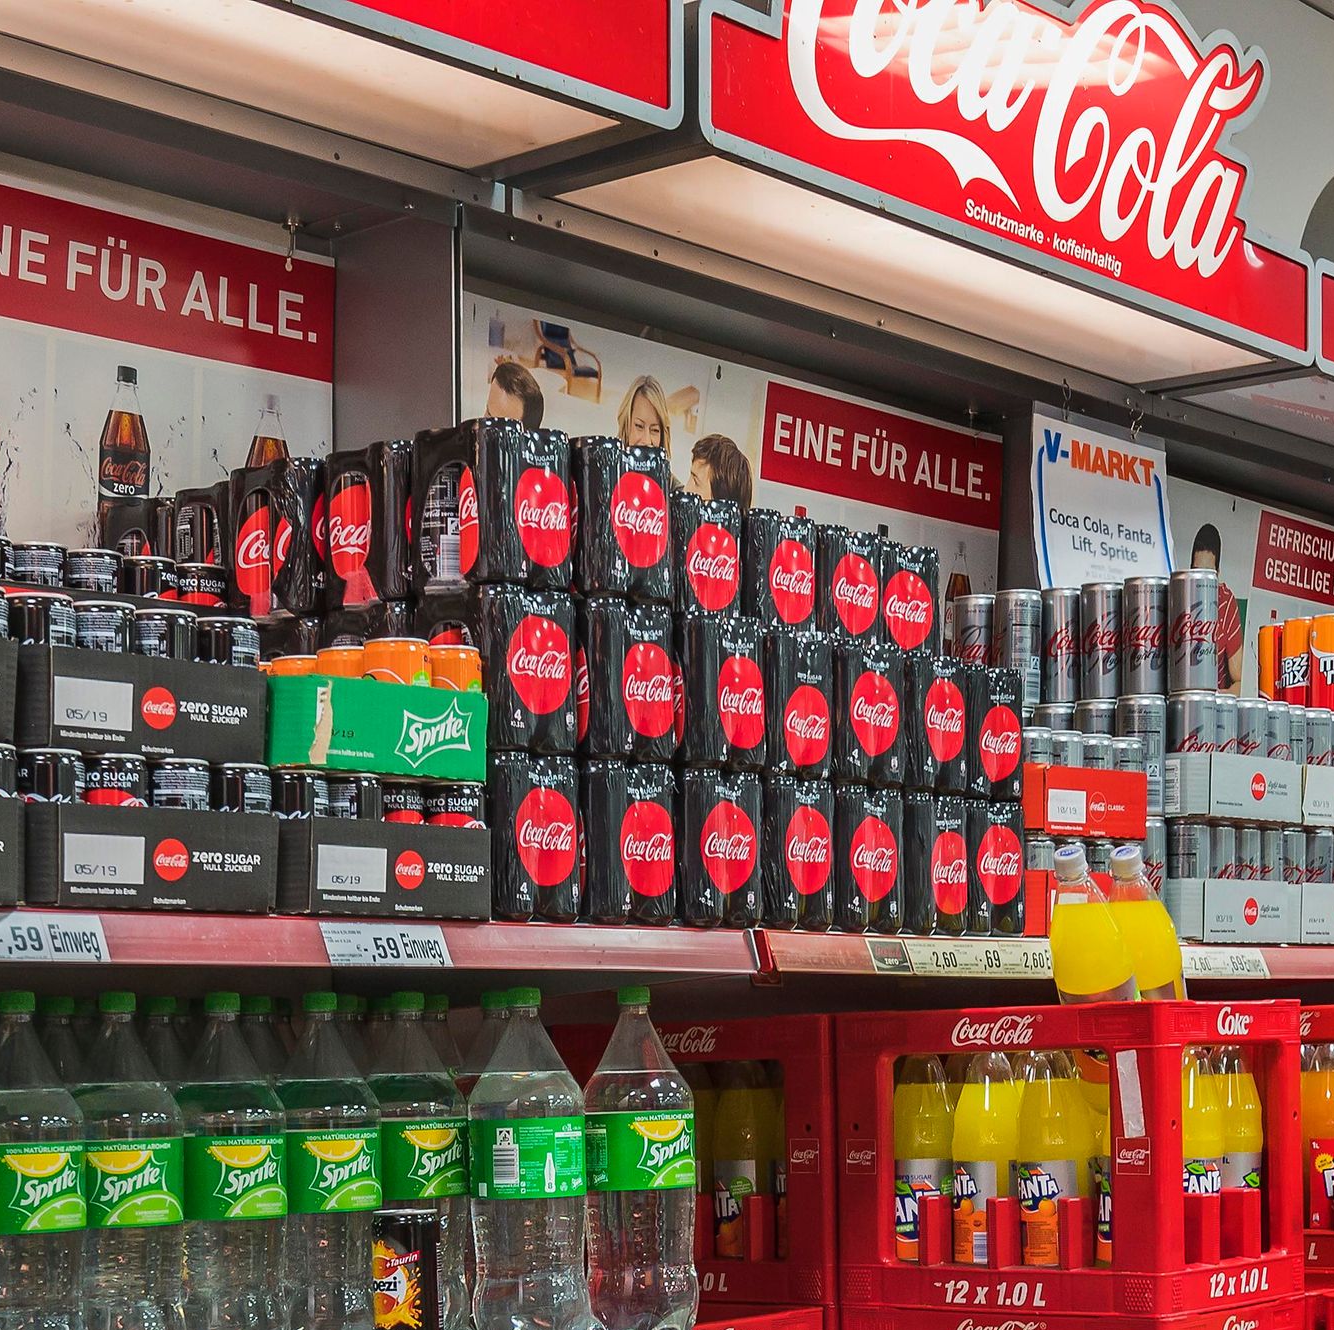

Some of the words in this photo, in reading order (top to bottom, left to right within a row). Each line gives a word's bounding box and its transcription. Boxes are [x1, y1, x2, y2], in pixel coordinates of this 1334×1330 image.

[964, 199, 1044, 244] Schutzmarke
[1053, 232, 1123, 277] koffeinhaltig
[67, 237, 167, 311] FÜR
[180, 271, 318, 343] ALLE.
[772, 411, 846, 462] EINE
[851, 428, 907, 476] FÜR
[911, 450, 992, 500] ALLE.
[1044, 429, 1154, 487] V-MARKT
[113, 482, 136, 494] zero
[1049, 508, 1079, 529] Coca
[1083, 517, 1114, 538] Cola,
[1118, 524, 1156, 547] Fanta,
[1072, 535, 1097, 557] Lift,
[1100, 542, 1138, 562] Sprite
[1264, 560, 1331, 595] GESELLIGE
[405, 712, 463, 756] Sprite
[331, 875, 360, 884] 05/19
[428, 862, 452, 873] zero
[454, 864, 484, 875] SUGAR
[454, 874, 478, 882] ZUCKER
[402, 933, 442, 965] Einweg
[934, 950, 958, 969] 2,60
[951, 1015, 1035, 1048] Coca-Cola
[1217, 1006, 1249, 1036] Coke
[24, 1165, 77, 1206] Sprite
[104, 1162, 163, 1200] Sprite
[385, 1253, 418, 1269] +Taurin
